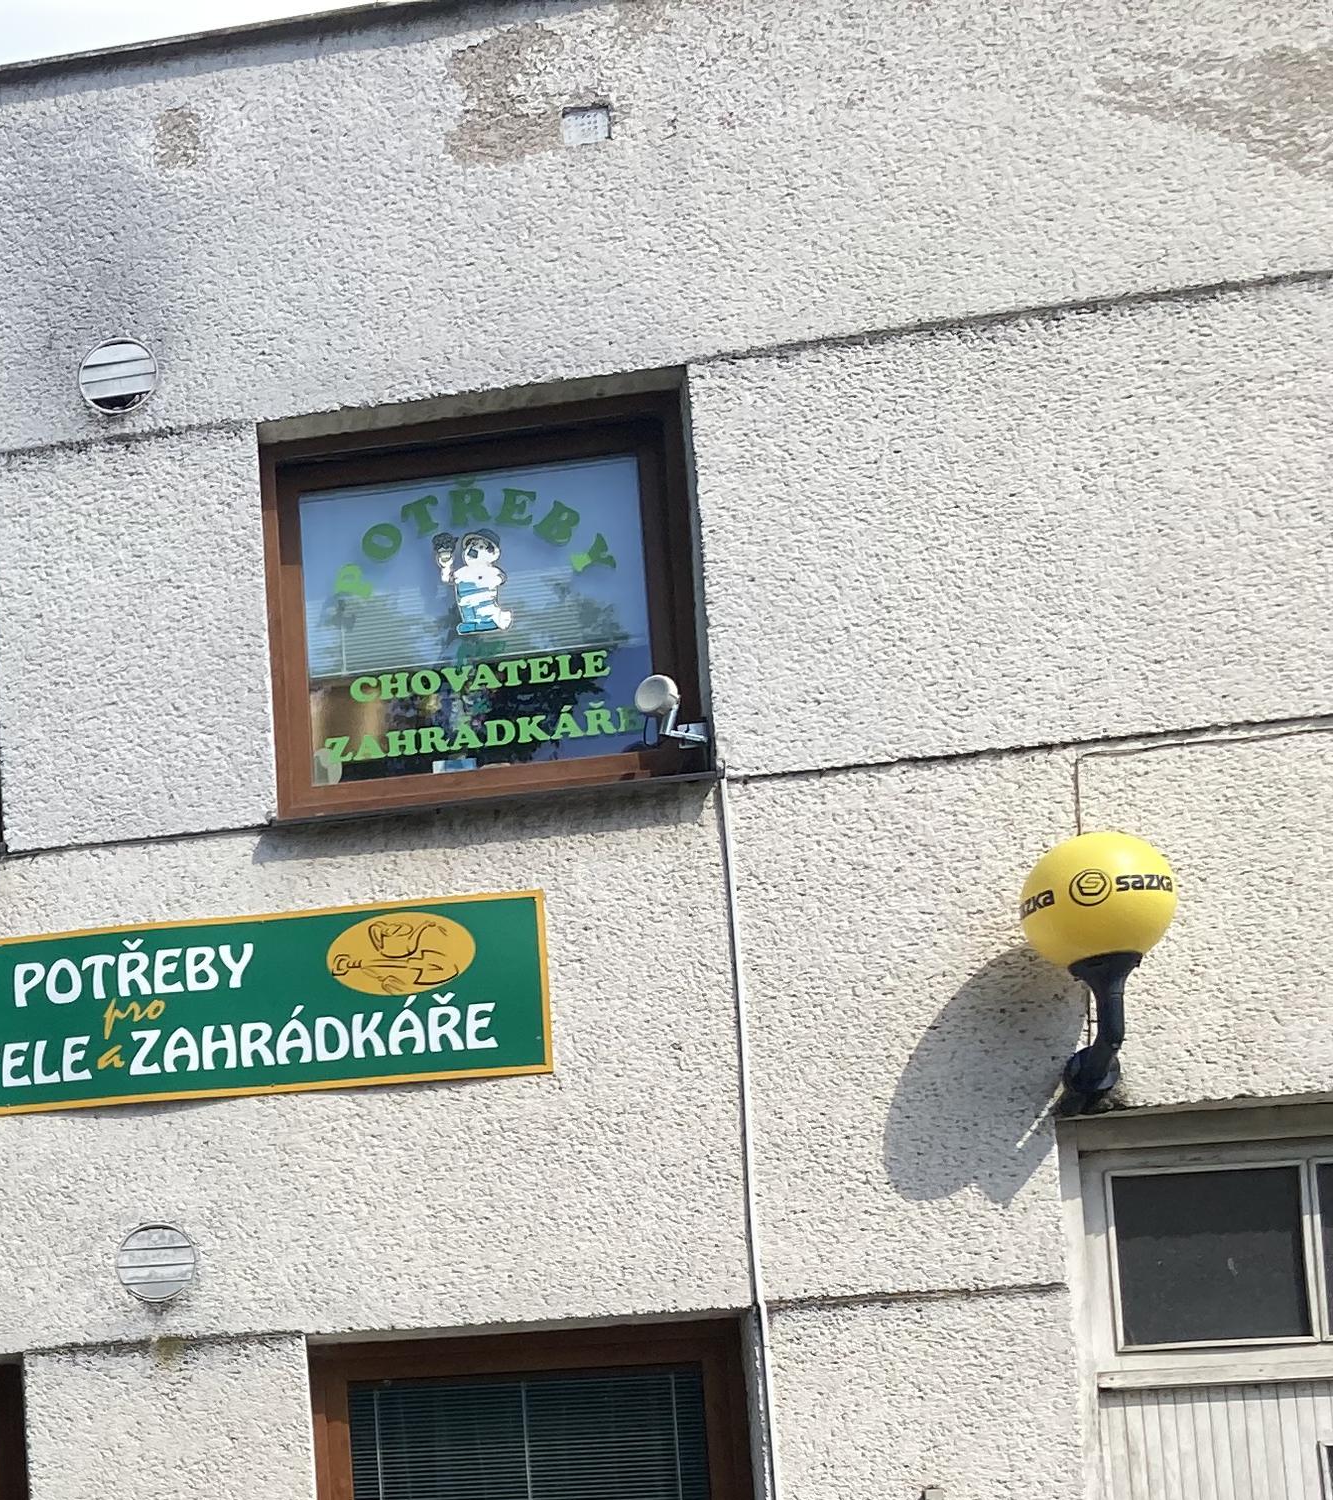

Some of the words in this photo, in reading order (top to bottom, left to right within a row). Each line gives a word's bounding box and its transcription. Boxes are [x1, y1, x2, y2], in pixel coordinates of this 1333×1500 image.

[334, 477, 617, 599] POTŘEBY
[349, 650, 610, 703] CHOVATELE
[325, 702, 644, 763] ZAHRÁDKÁŘE
[1115, 874, 1174, 893] sazka
[13, 938, 254, 1008] POTŘEBY
[96, 1045, 125, 1070] a
[129, 992, 499, 1076] ZAHRÁDKÁŘE
[102, 997, 166, 1041] pro
